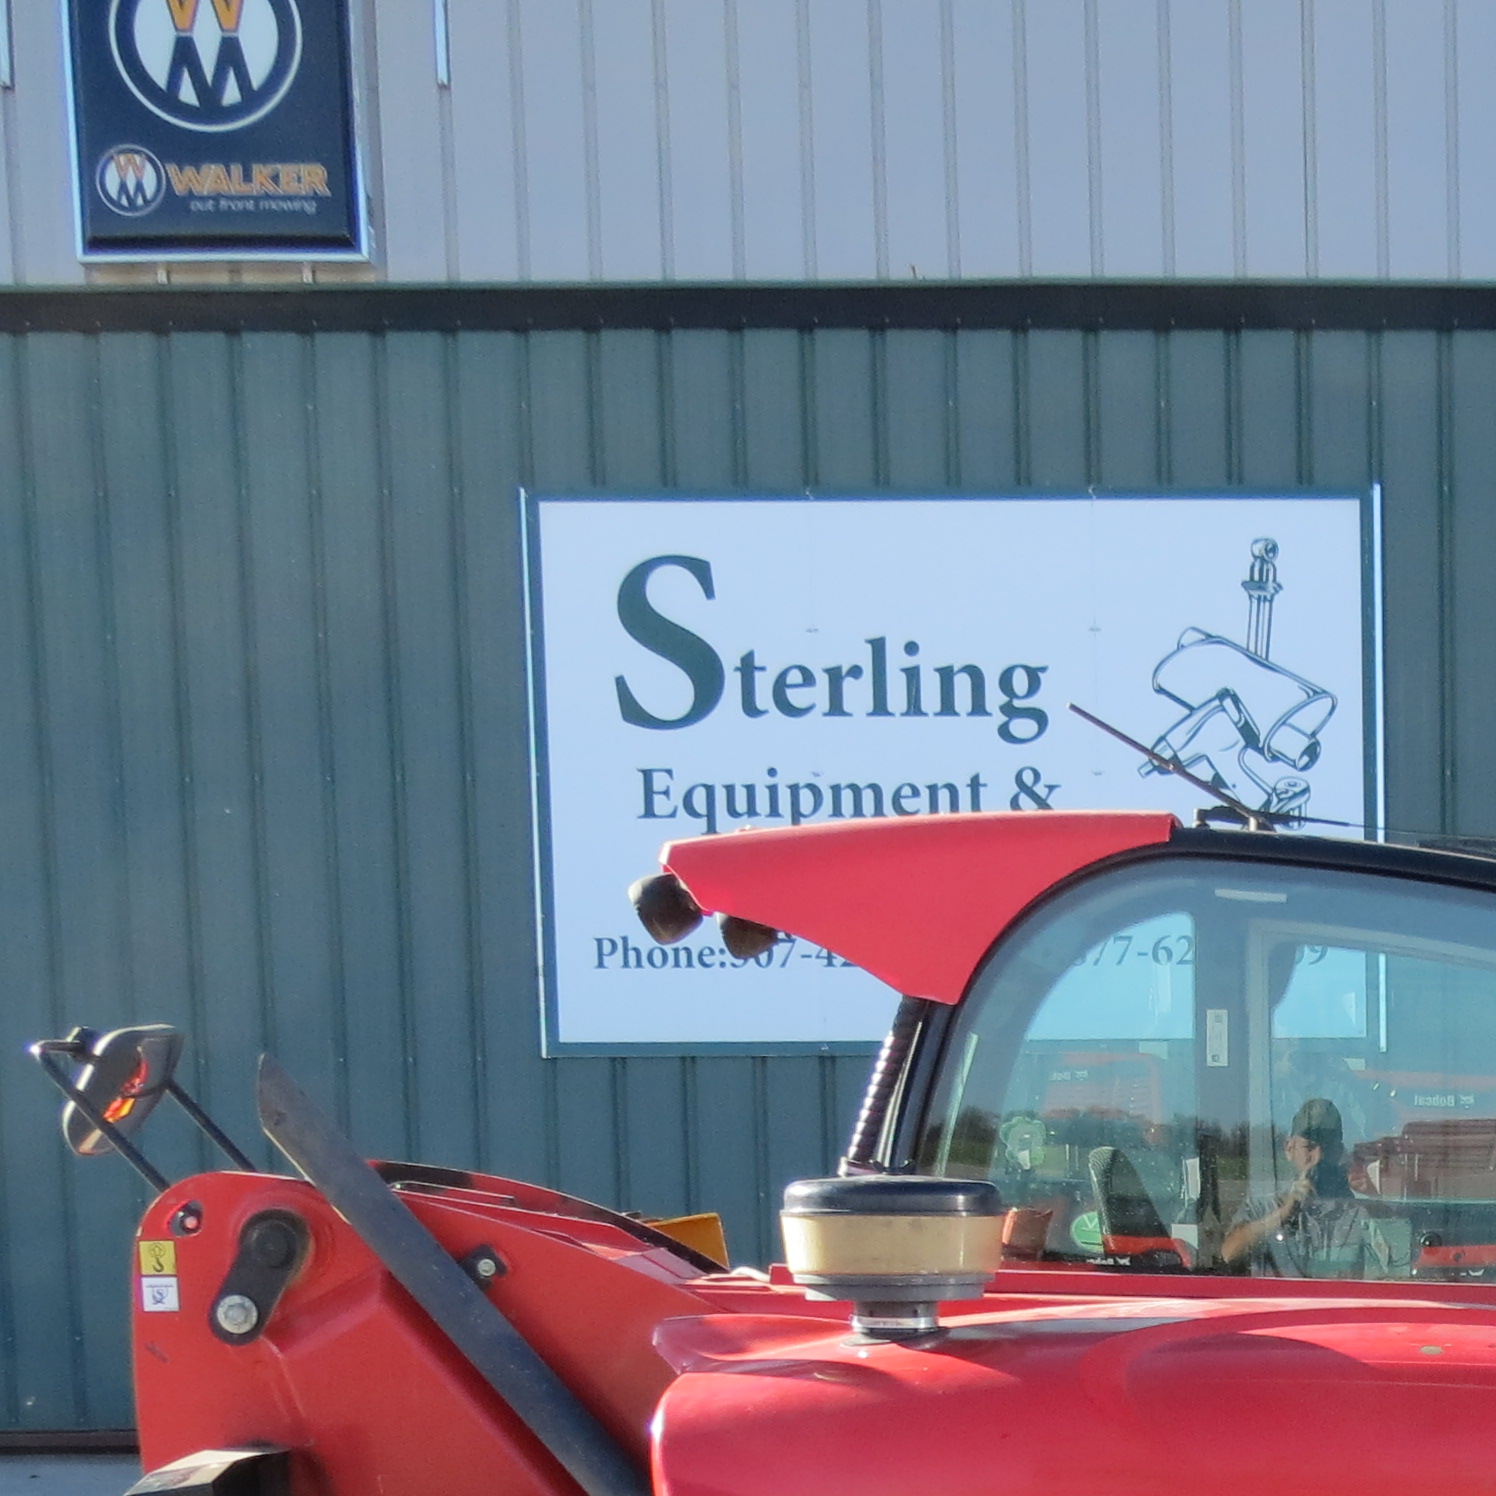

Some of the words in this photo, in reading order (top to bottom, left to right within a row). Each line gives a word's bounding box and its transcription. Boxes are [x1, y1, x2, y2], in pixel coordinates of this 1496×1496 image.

[166, 163, 331, 197] WALKER
[615, 555, 1049, 744] Sterling
[637, 767, 988, 834] Equipment
